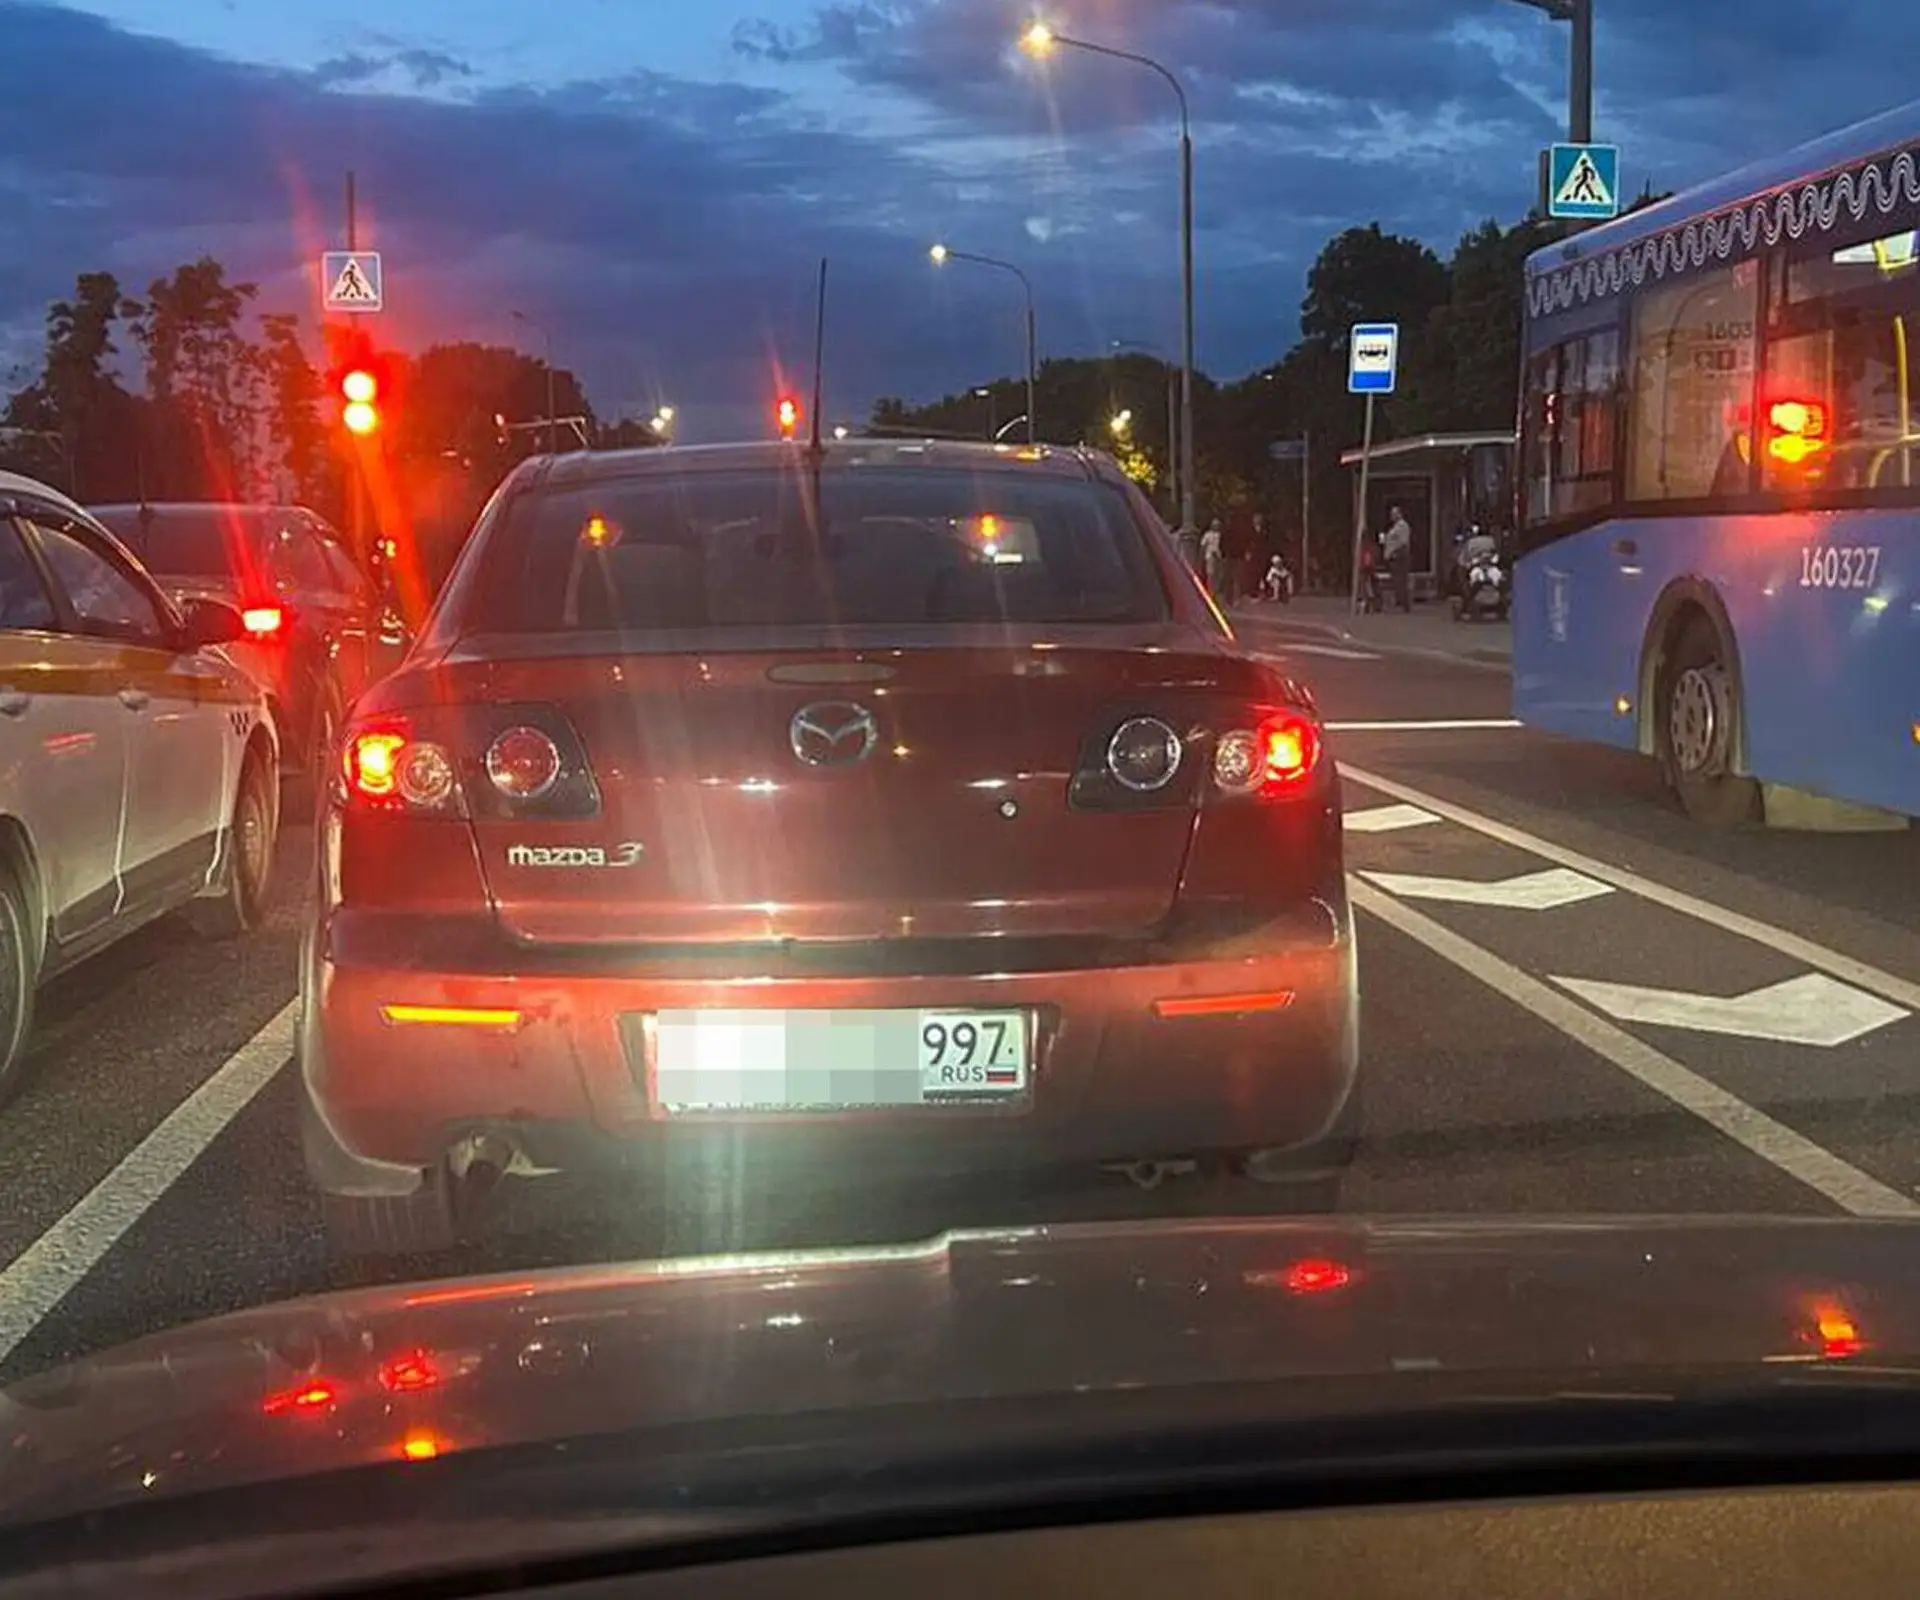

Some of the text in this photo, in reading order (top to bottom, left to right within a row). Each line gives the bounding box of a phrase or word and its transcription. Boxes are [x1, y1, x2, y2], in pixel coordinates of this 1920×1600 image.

[1800, 546, 1880, 587] 160327
[608, 842, 644, 867] 3
[923, 1021, 1006, 1066] 997
[941, 1065, 984, 1082] RUS
